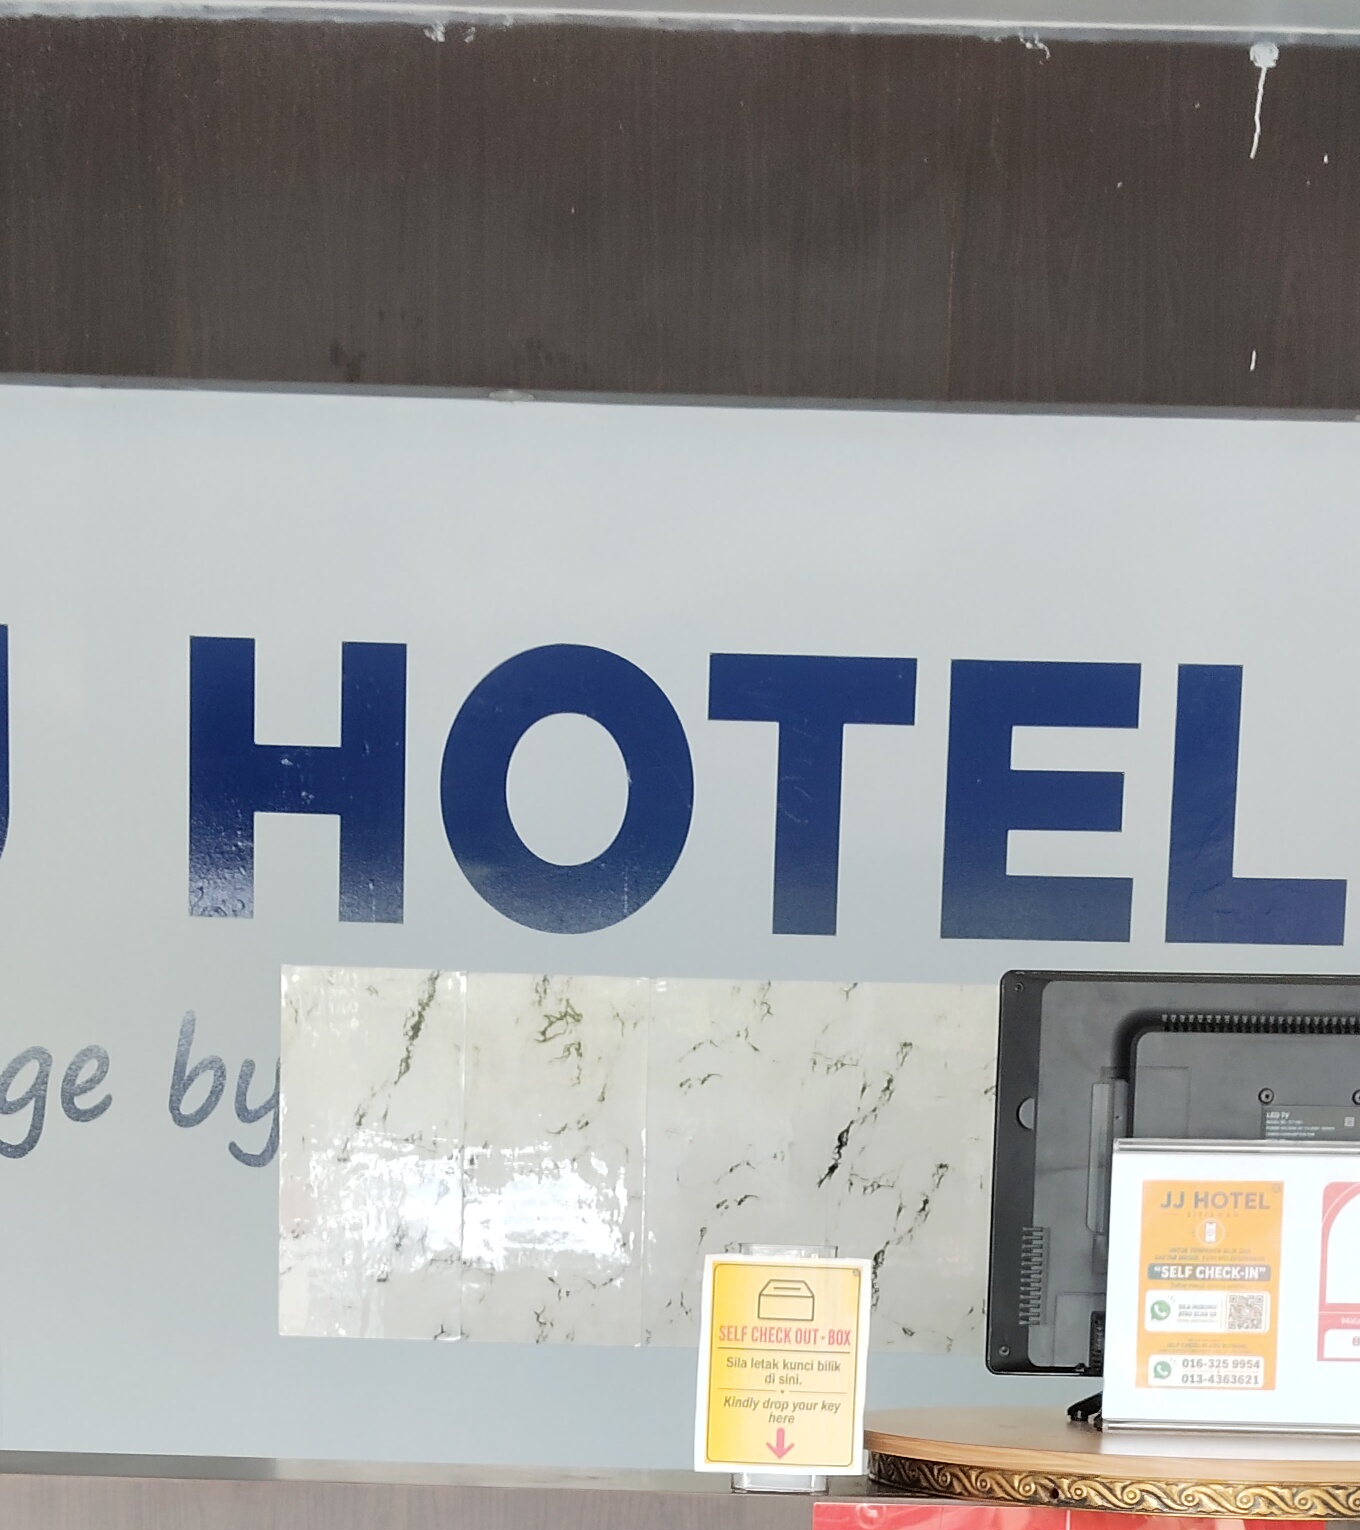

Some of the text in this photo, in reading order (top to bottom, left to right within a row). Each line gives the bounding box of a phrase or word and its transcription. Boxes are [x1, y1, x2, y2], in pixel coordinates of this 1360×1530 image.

[188, 635, 1348, 947] HOTEL
[1160, 1191, 1270, 1209] JJ HOTEL
[719, 1325, 748, 1342] SELF
[751, 1326, 791, 1344] CHECK
[795, 1327, 819, 1345] OUT
[828, 1328, 851, 1346] BOX
[726, 1357, 841, 1372] Sila letak kunci bilik
[764, 1373, 802, 1386] di sini.
[723, 1396, 841, 1414] Kindly drop your key
[768, 1412, 795, 1424] here
